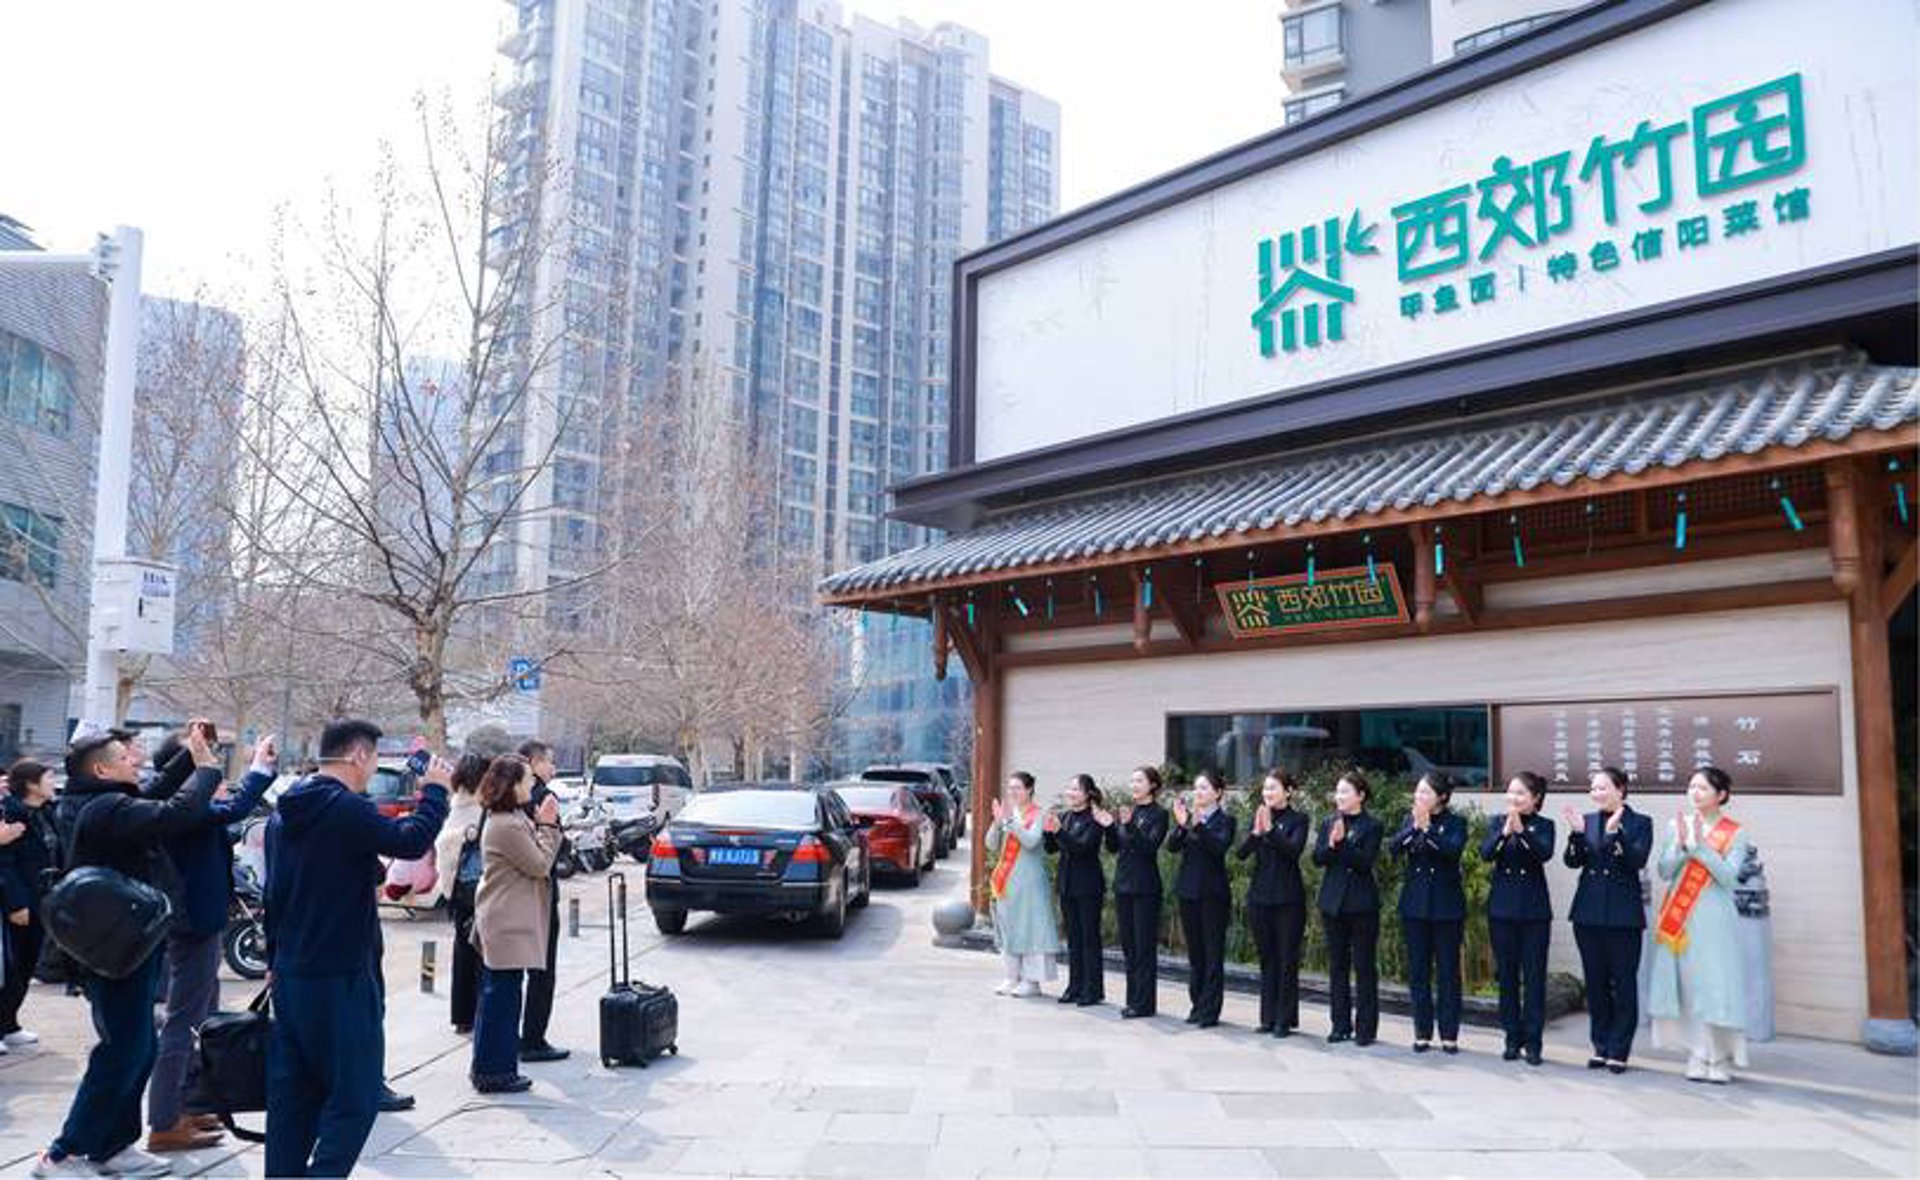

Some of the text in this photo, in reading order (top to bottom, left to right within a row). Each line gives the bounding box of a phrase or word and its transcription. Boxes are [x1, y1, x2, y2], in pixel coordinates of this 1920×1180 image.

[1390, 73, 1808, 283] 西郊竹园
[1546, 187, 1811, 283] 特色信阳菜馆
